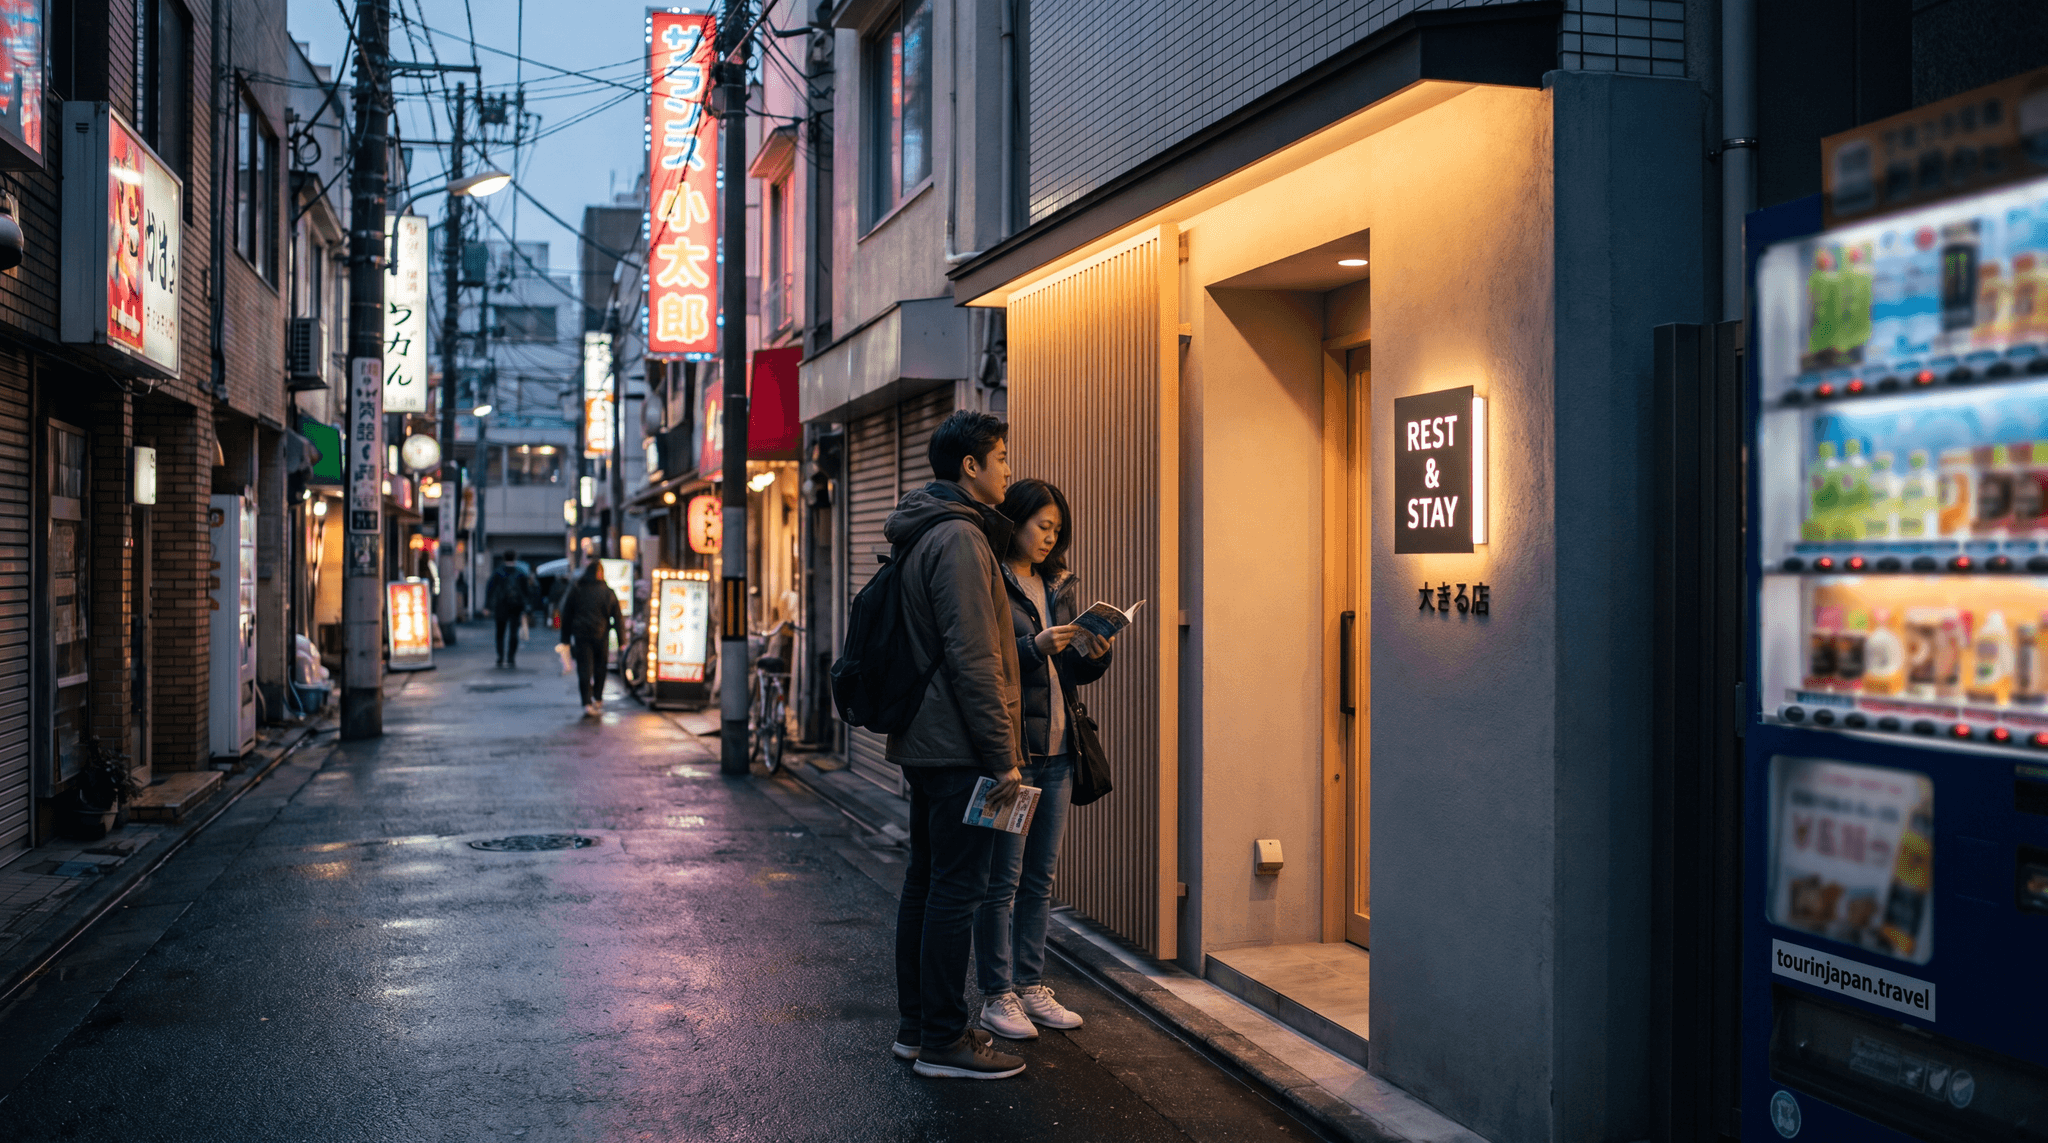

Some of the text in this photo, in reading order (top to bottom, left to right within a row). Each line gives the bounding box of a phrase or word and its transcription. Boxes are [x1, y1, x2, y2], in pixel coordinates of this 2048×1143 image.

[1407, 415, 1458, 452] REST
[1424, 457, 1440, 489] &
[1407, 496, 1459, 529] STAY
[1418, 581, 1491, 616] 大きる店
[1776, 948, 1930, 1011] tourinjapan.travel
